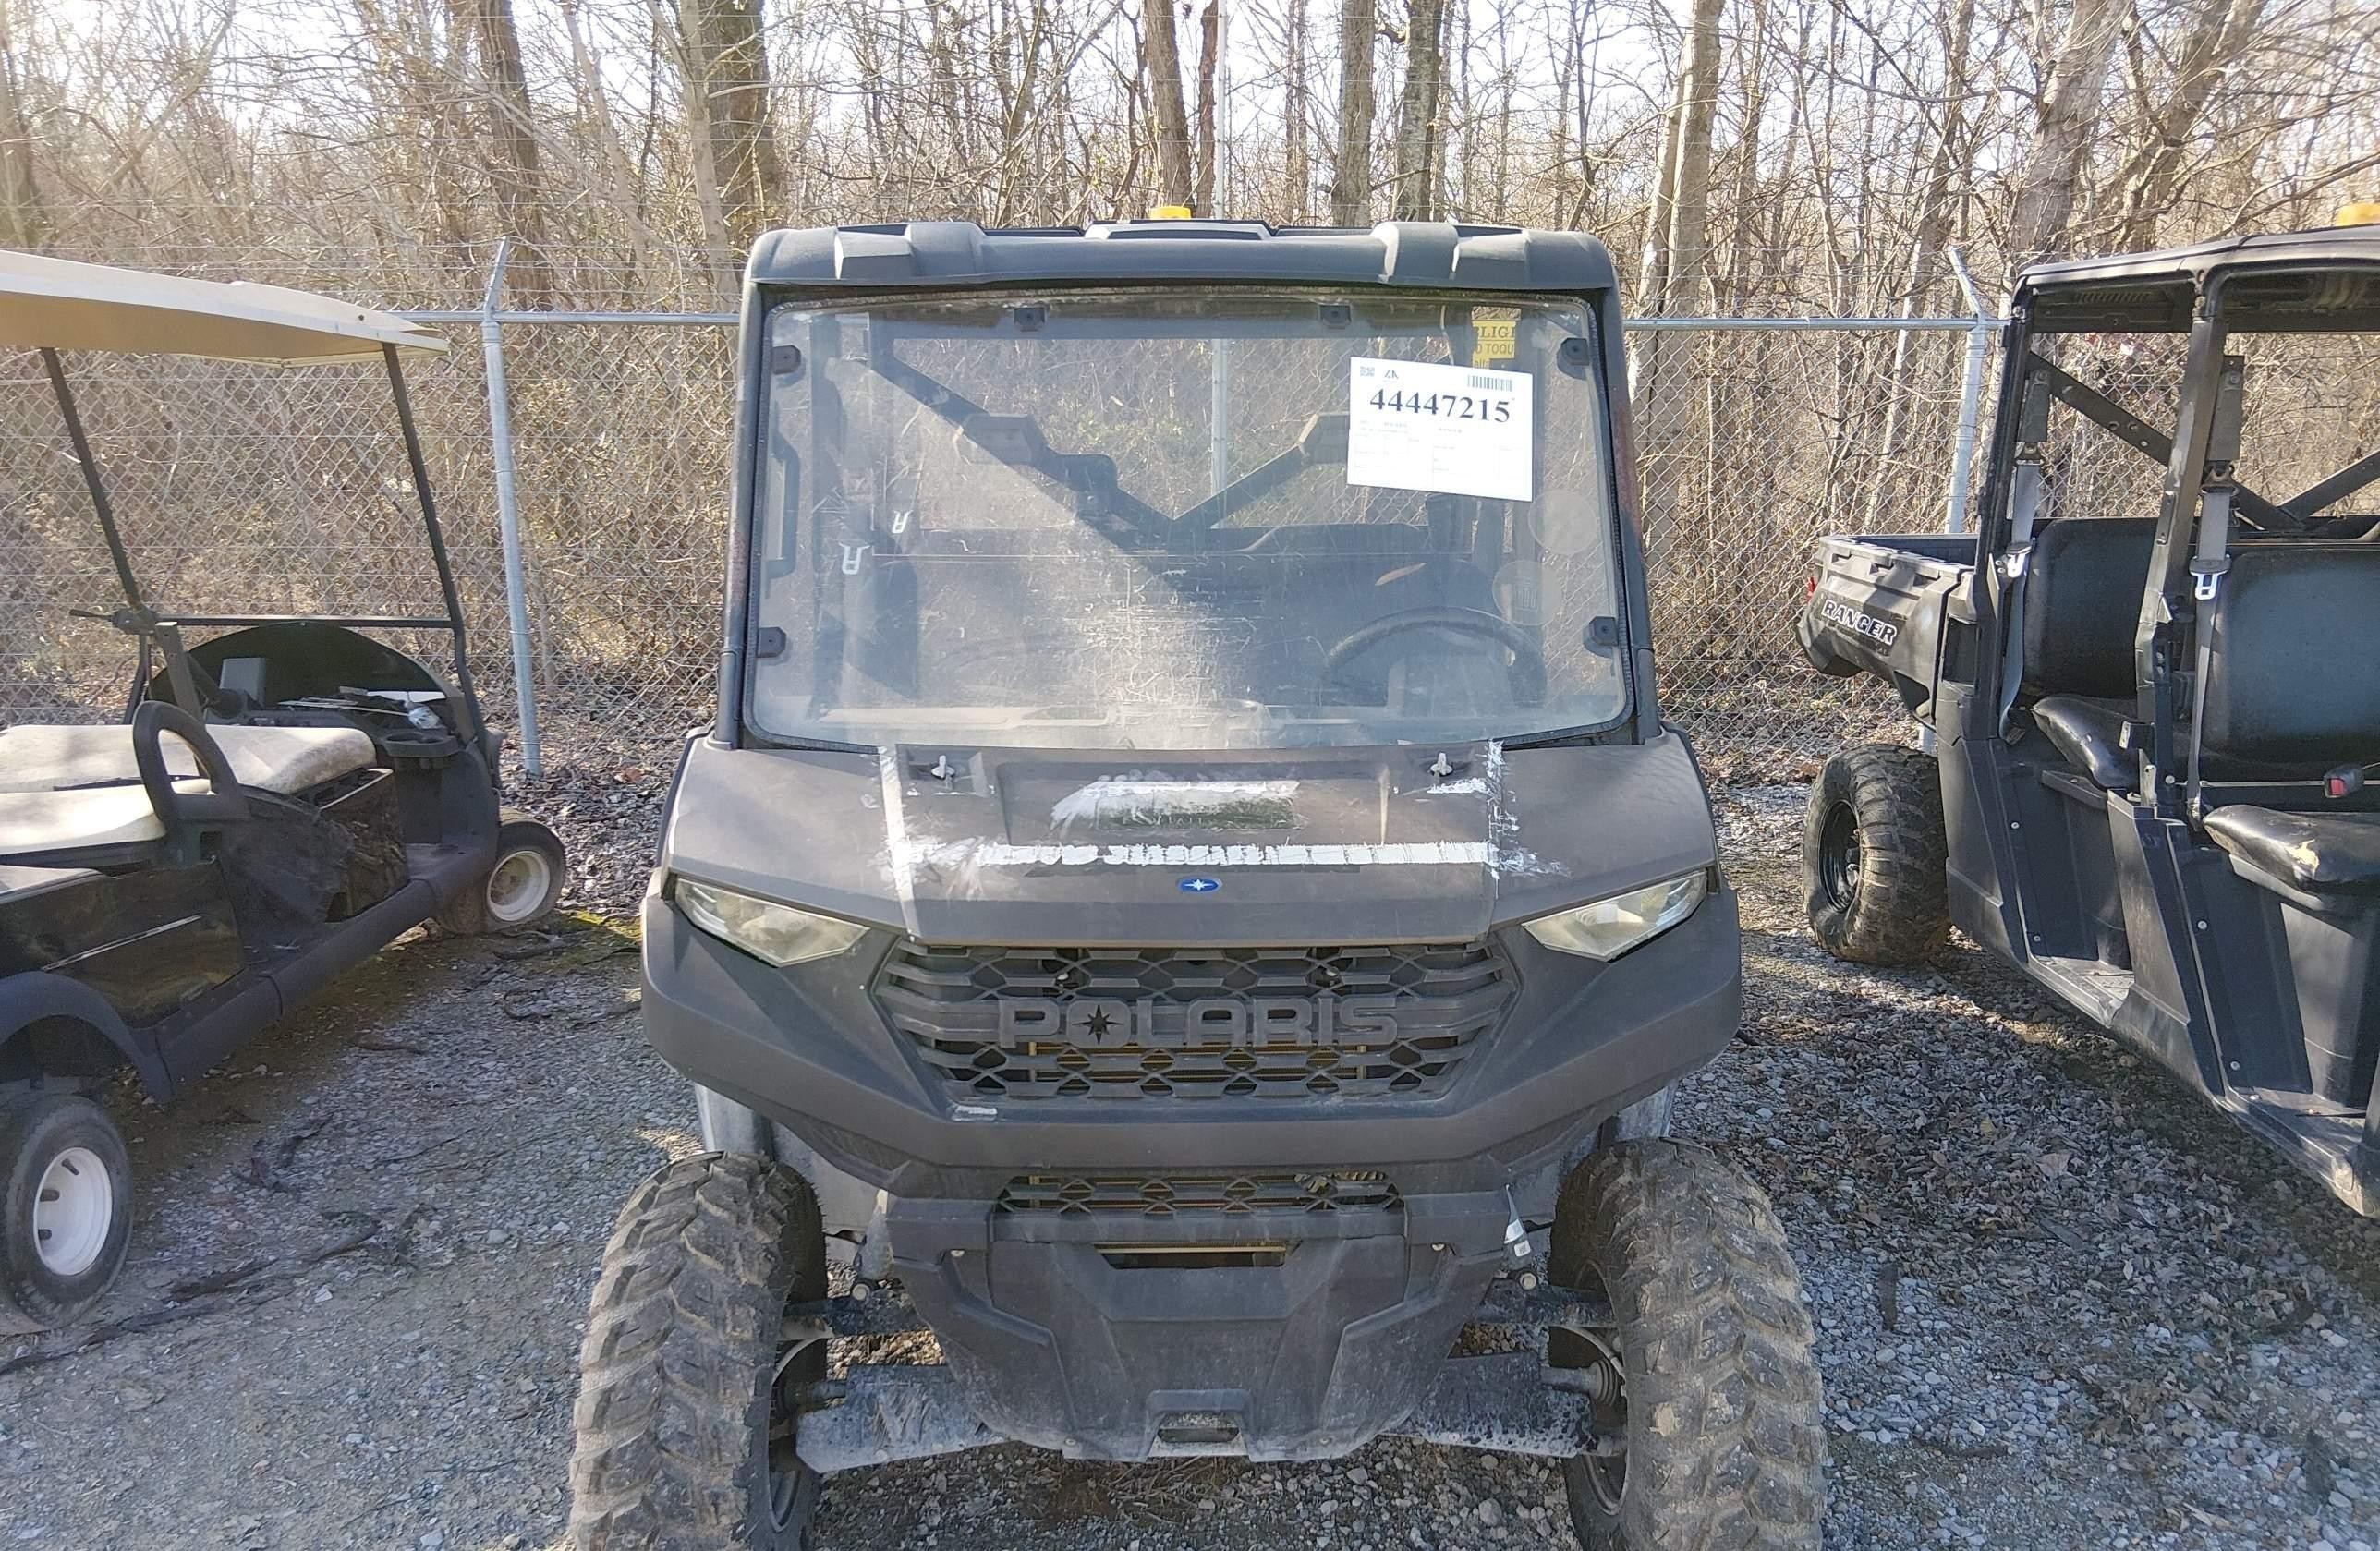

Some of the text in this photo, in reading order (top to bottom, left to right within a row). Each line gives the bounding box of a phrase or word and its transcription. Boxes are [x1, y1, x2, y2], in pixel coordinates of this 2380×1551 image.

[1369, 388, 1511, 423] 44447215
[1821, 599, 1897, 647] RANGER
[998, 996, 1398, 1048] POLARIS
